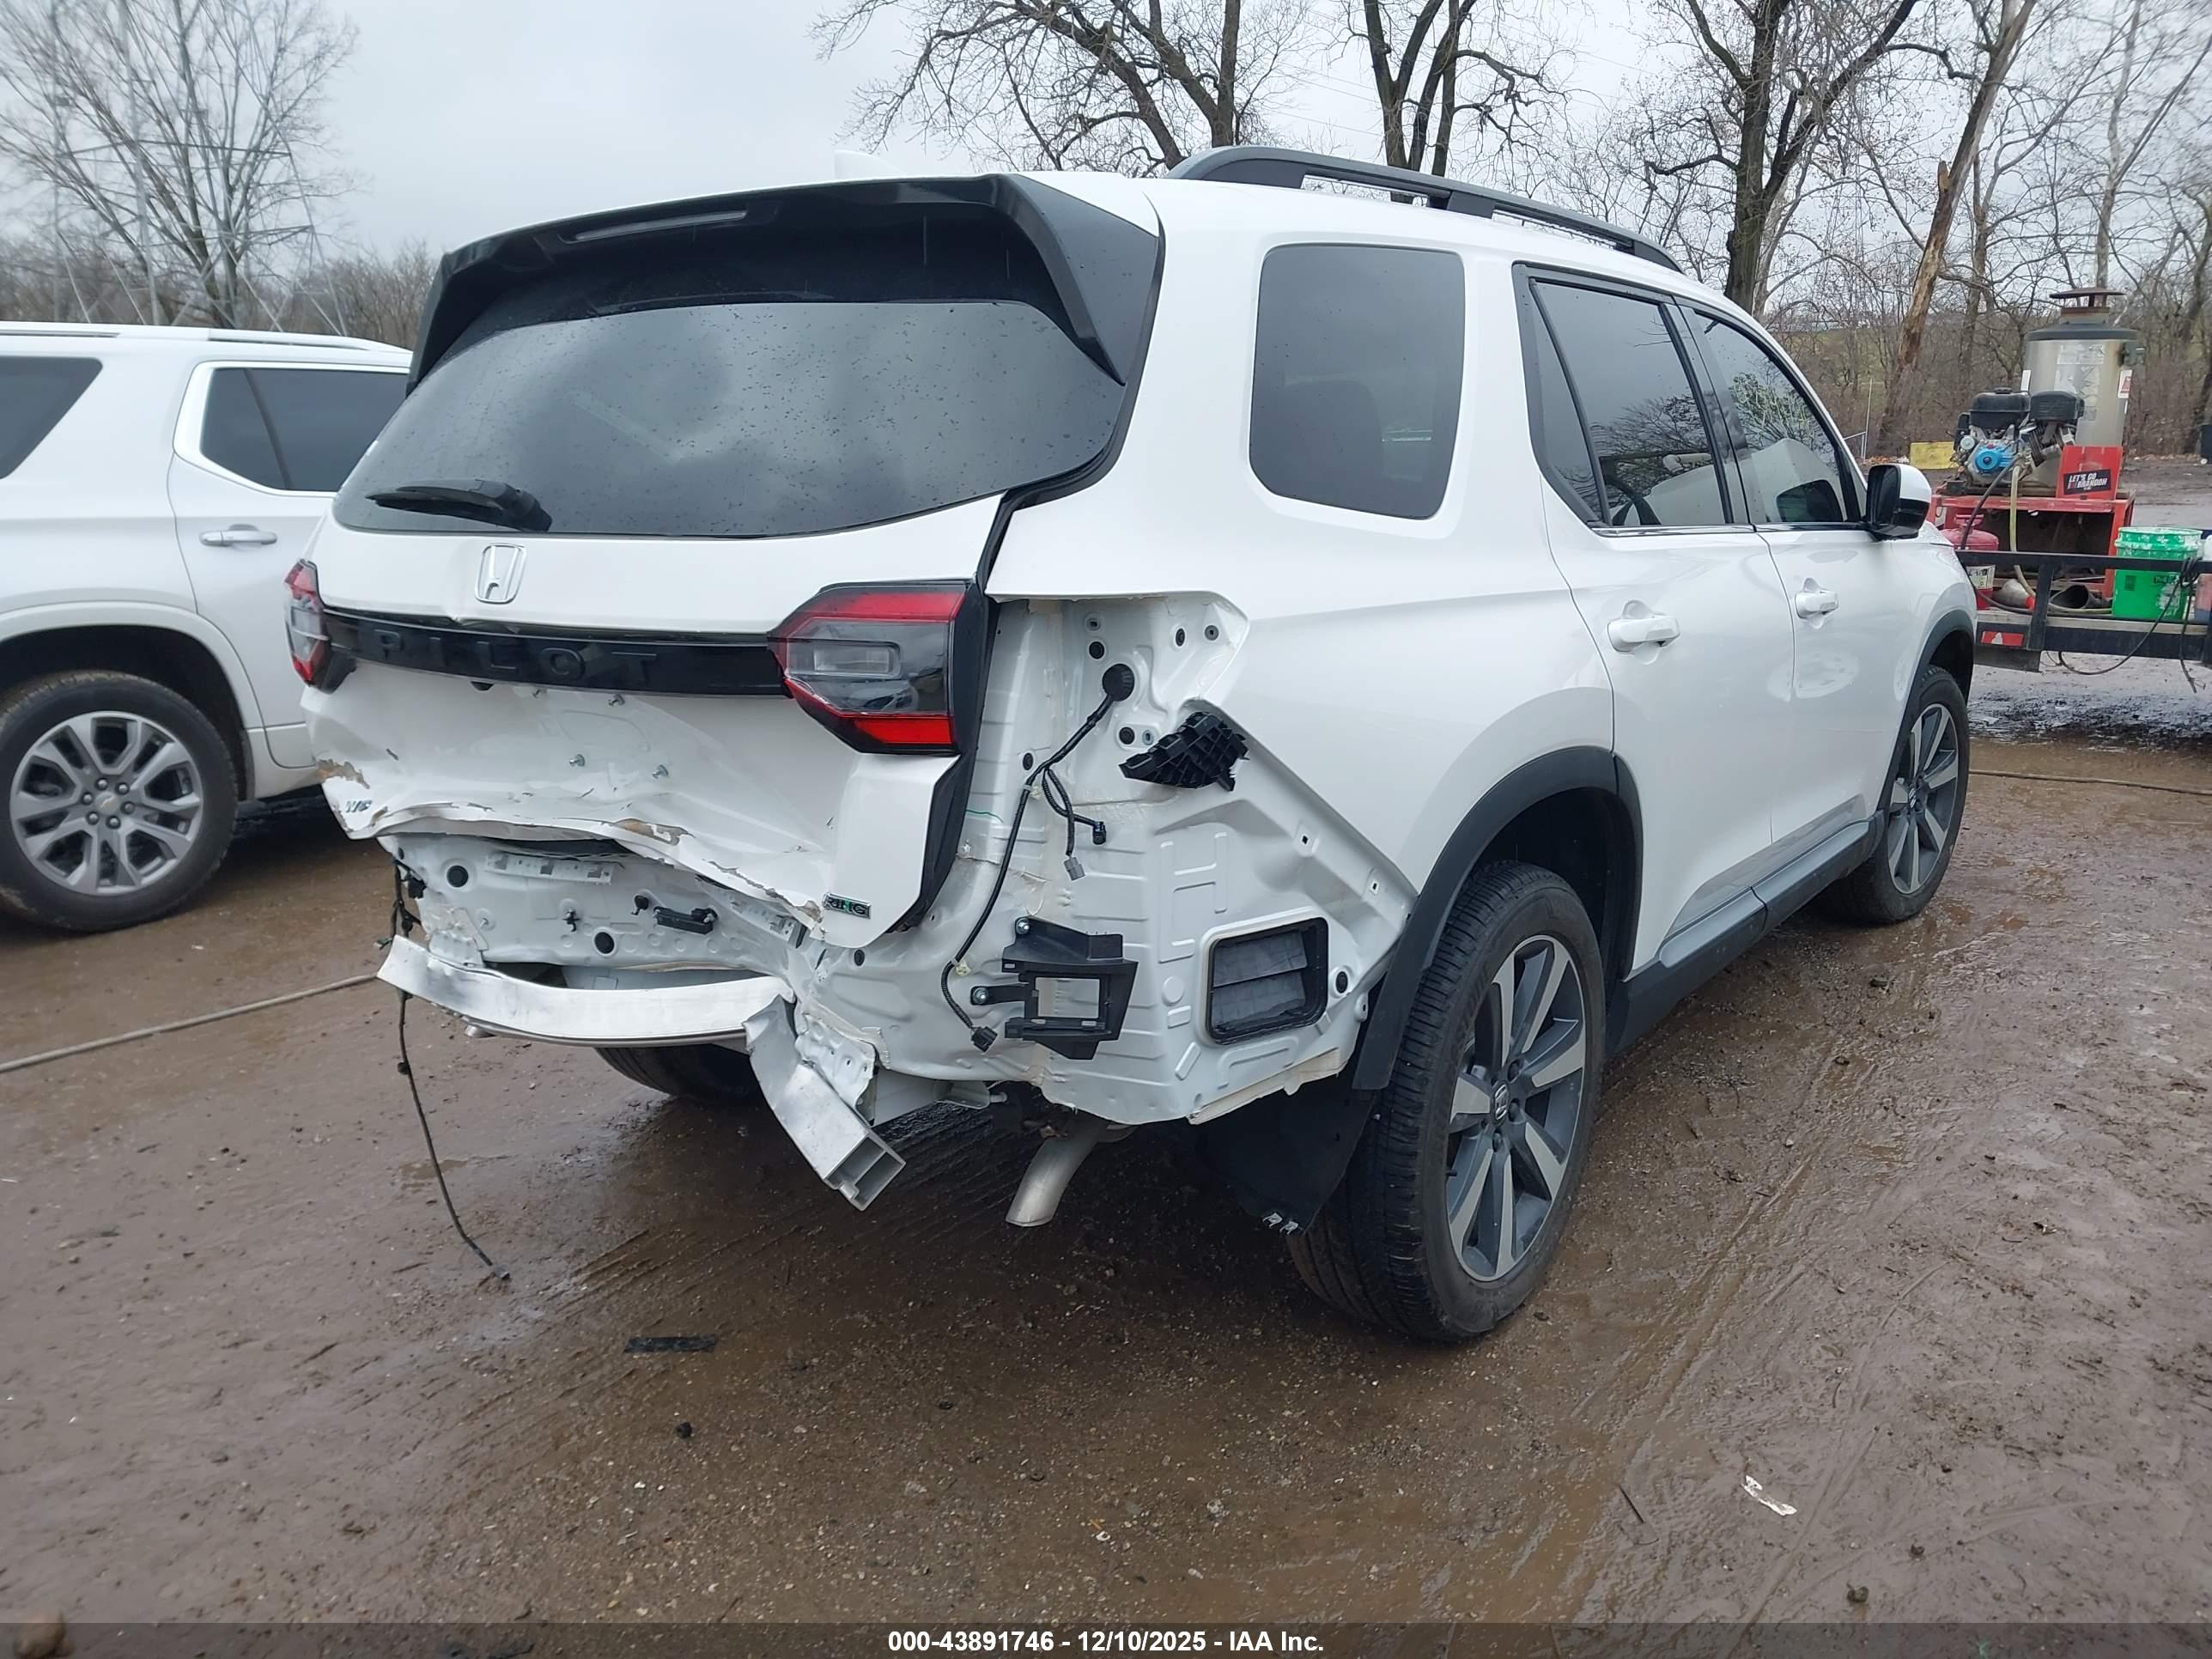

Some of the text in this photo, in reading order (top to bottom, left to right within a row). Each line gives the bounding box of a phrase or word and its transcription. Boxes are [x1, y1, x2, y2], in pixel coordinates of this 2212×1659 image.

[2069, 473, 2087, 482] LET'S
[2076, 478, 2108, 489] BRANDON
[374, 629, 658, 685] PILOT
